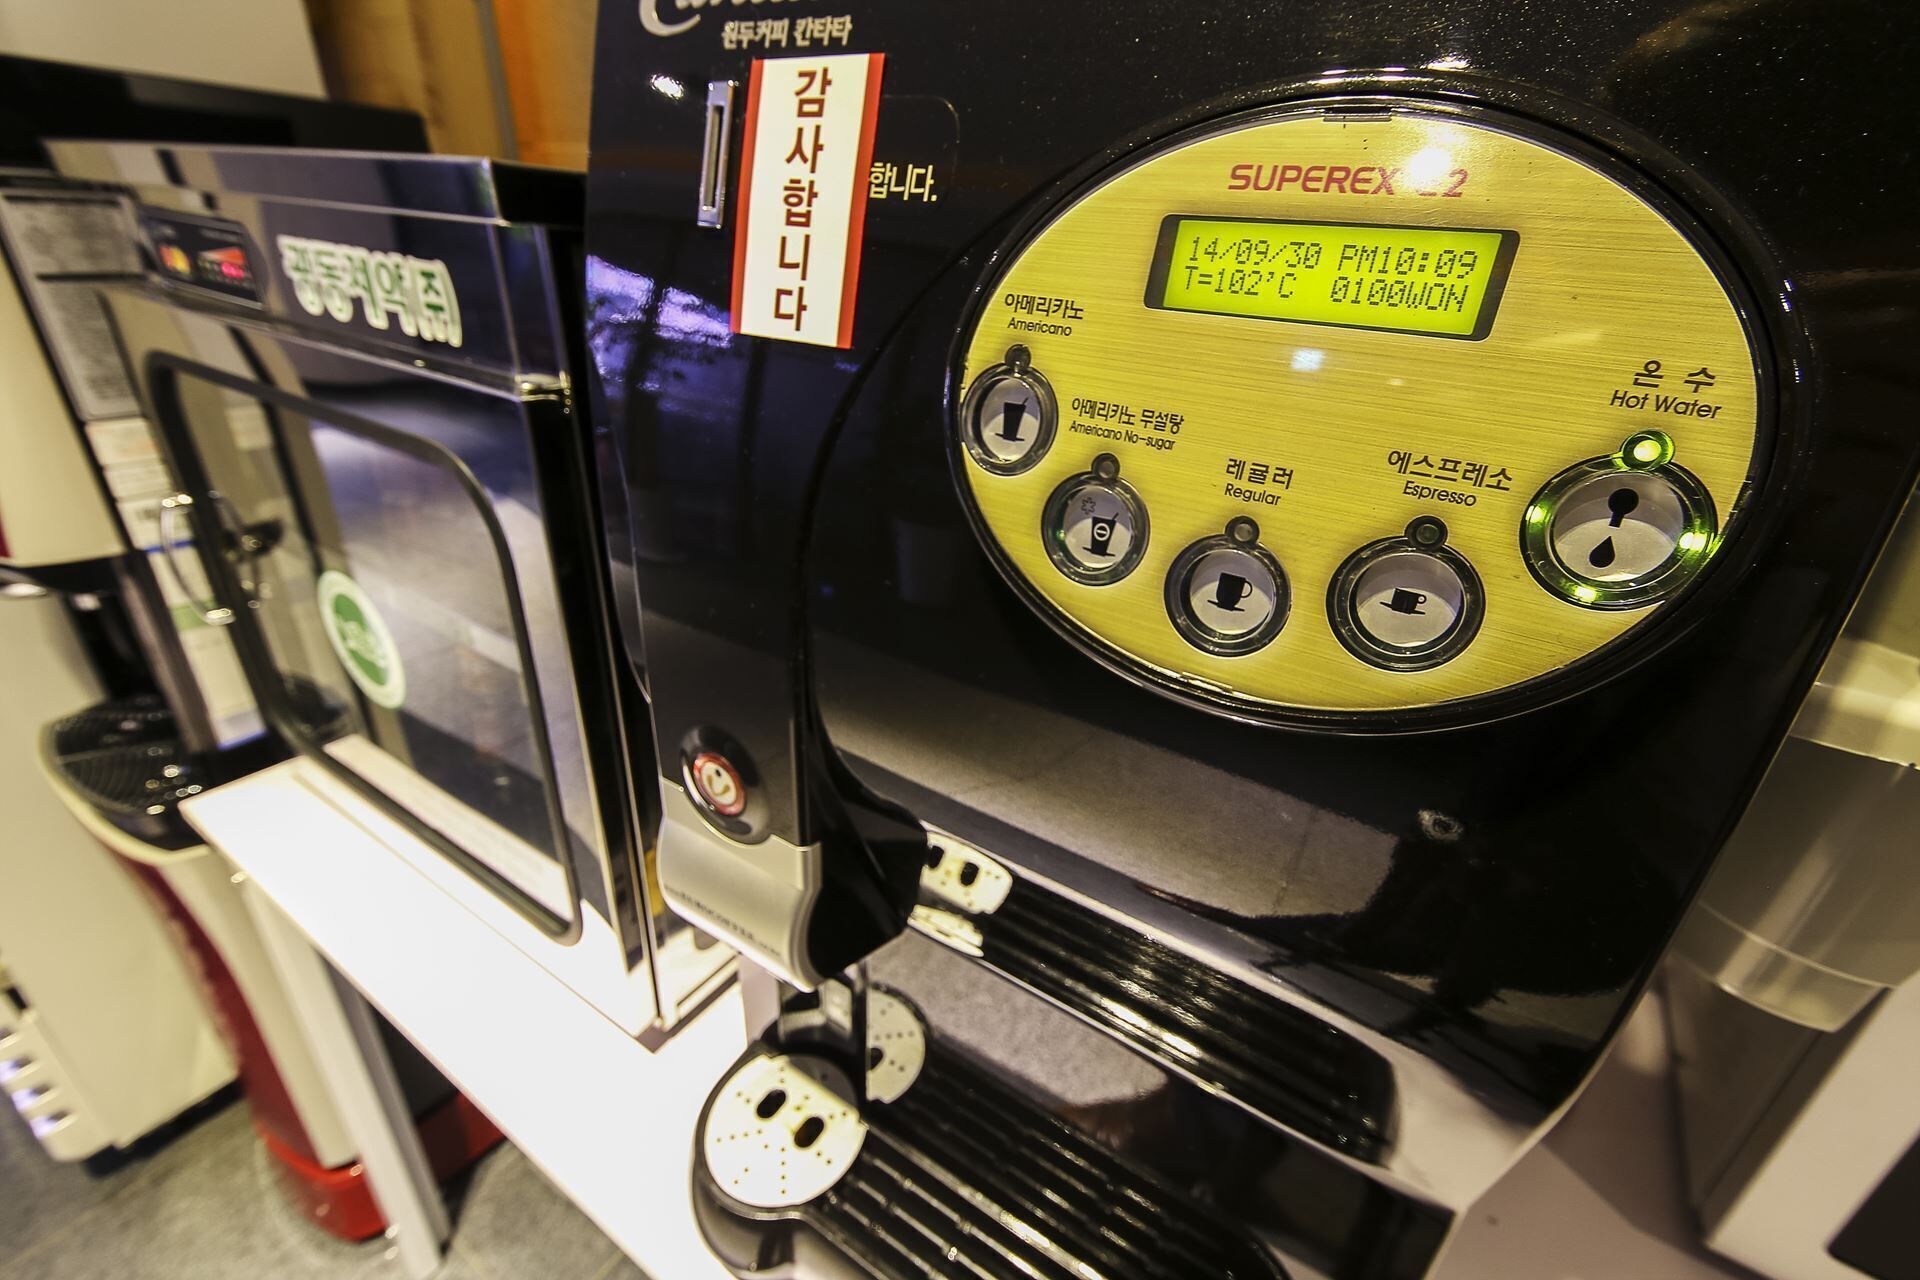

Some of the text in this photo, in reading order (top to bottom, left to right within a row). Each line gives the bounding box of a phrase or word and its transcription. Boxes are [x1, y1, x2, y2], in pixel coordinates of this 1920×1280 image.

[721, 17, 790, 50] 원두커피
[793, 14, 853, 47] 칸타타
[1227, 163, 1400, 196] SUPEREX
[773, 66, 832, 331] 감사합니다
[1189, 236, 1479, 280] 14/09/30 PM10:09
[1004, 293, 1085, 321] 아메리카노
[1330, 276, 1470, 313] 0100WON
[1006, 317, 1073, 337] Americano
[1071, 398, 1185, 435] 아메리카노 무설탕
[1609, 388, 1723, 420] Hot Water
[1068, 420, 1176, 451] Americano No-sugar
[1225, 457, 1295, 490] 레귤러
[1387, 448, 1513, 492] 에스프레소
[1224, 483, 1282, 507] Regular
[1402, 480, 1477, 508] Espresso
